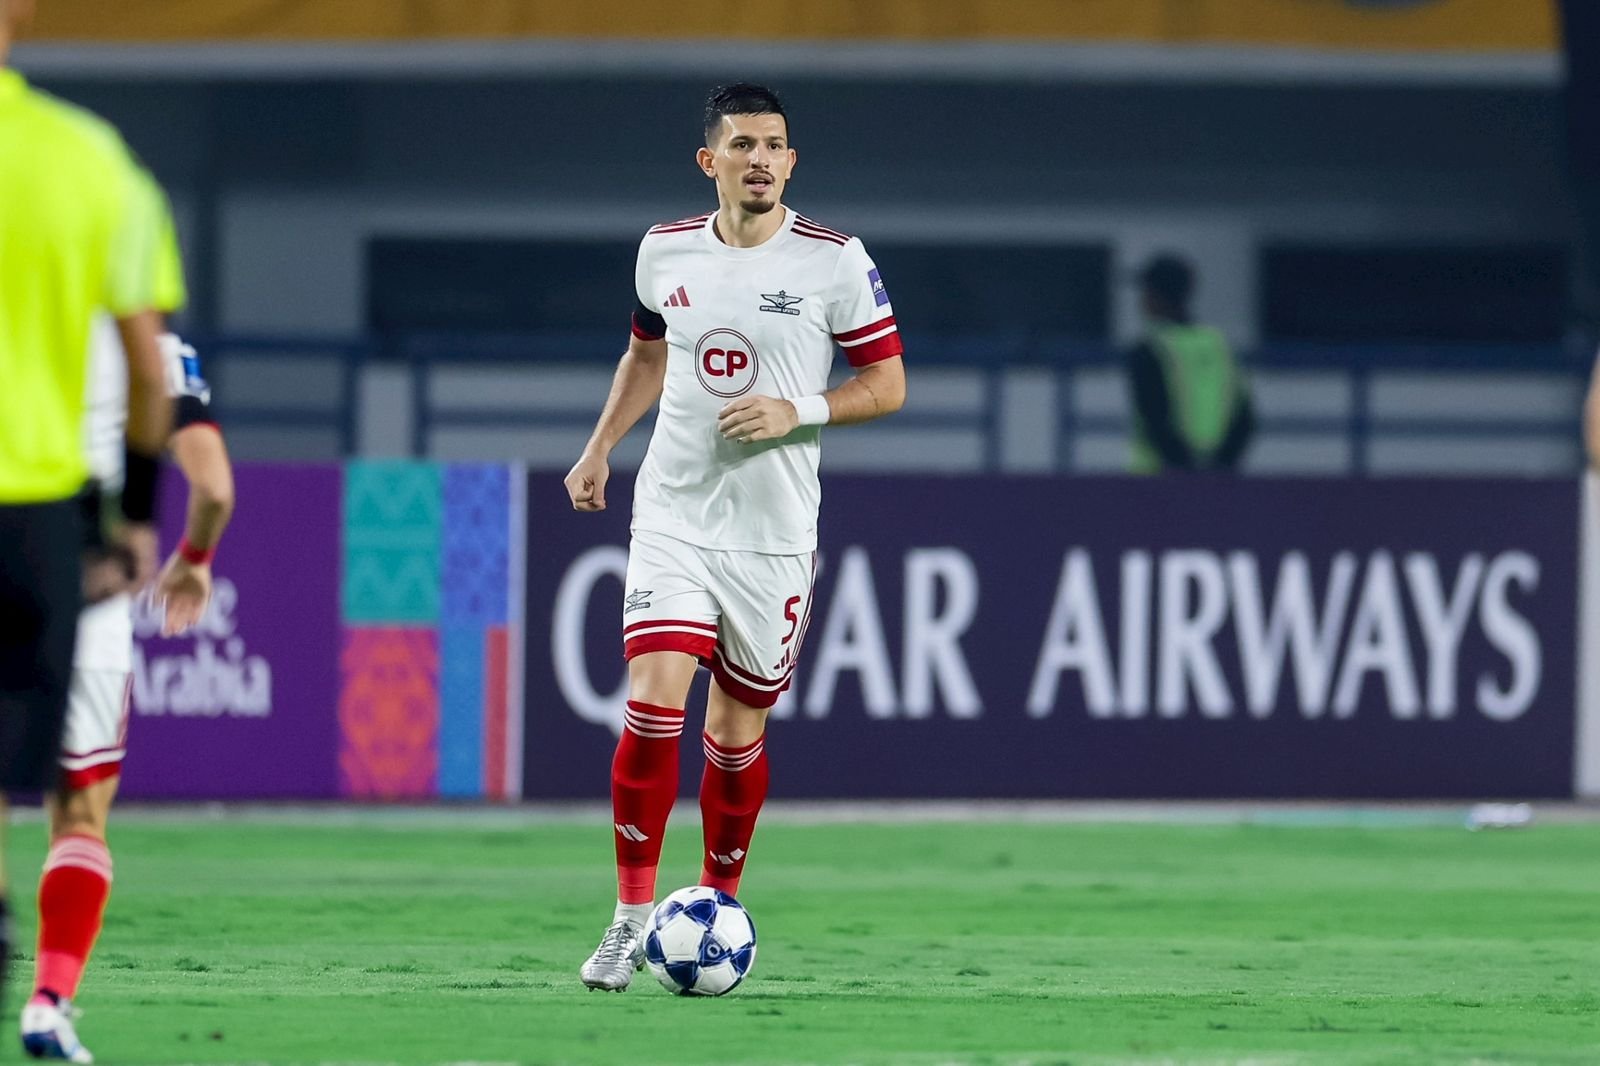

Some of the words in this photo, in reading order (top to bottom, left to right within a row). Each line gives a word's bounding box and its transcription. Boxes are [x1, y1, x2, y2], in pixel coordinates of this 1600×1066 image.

[873, 279, 884, 293] AF
[703, 348, 748, 377] CP
[781, 595, 801, 645] 5
[551, 545, 985, 737] QAR
[1026, 546, 1543, 720] AIRWAYS
